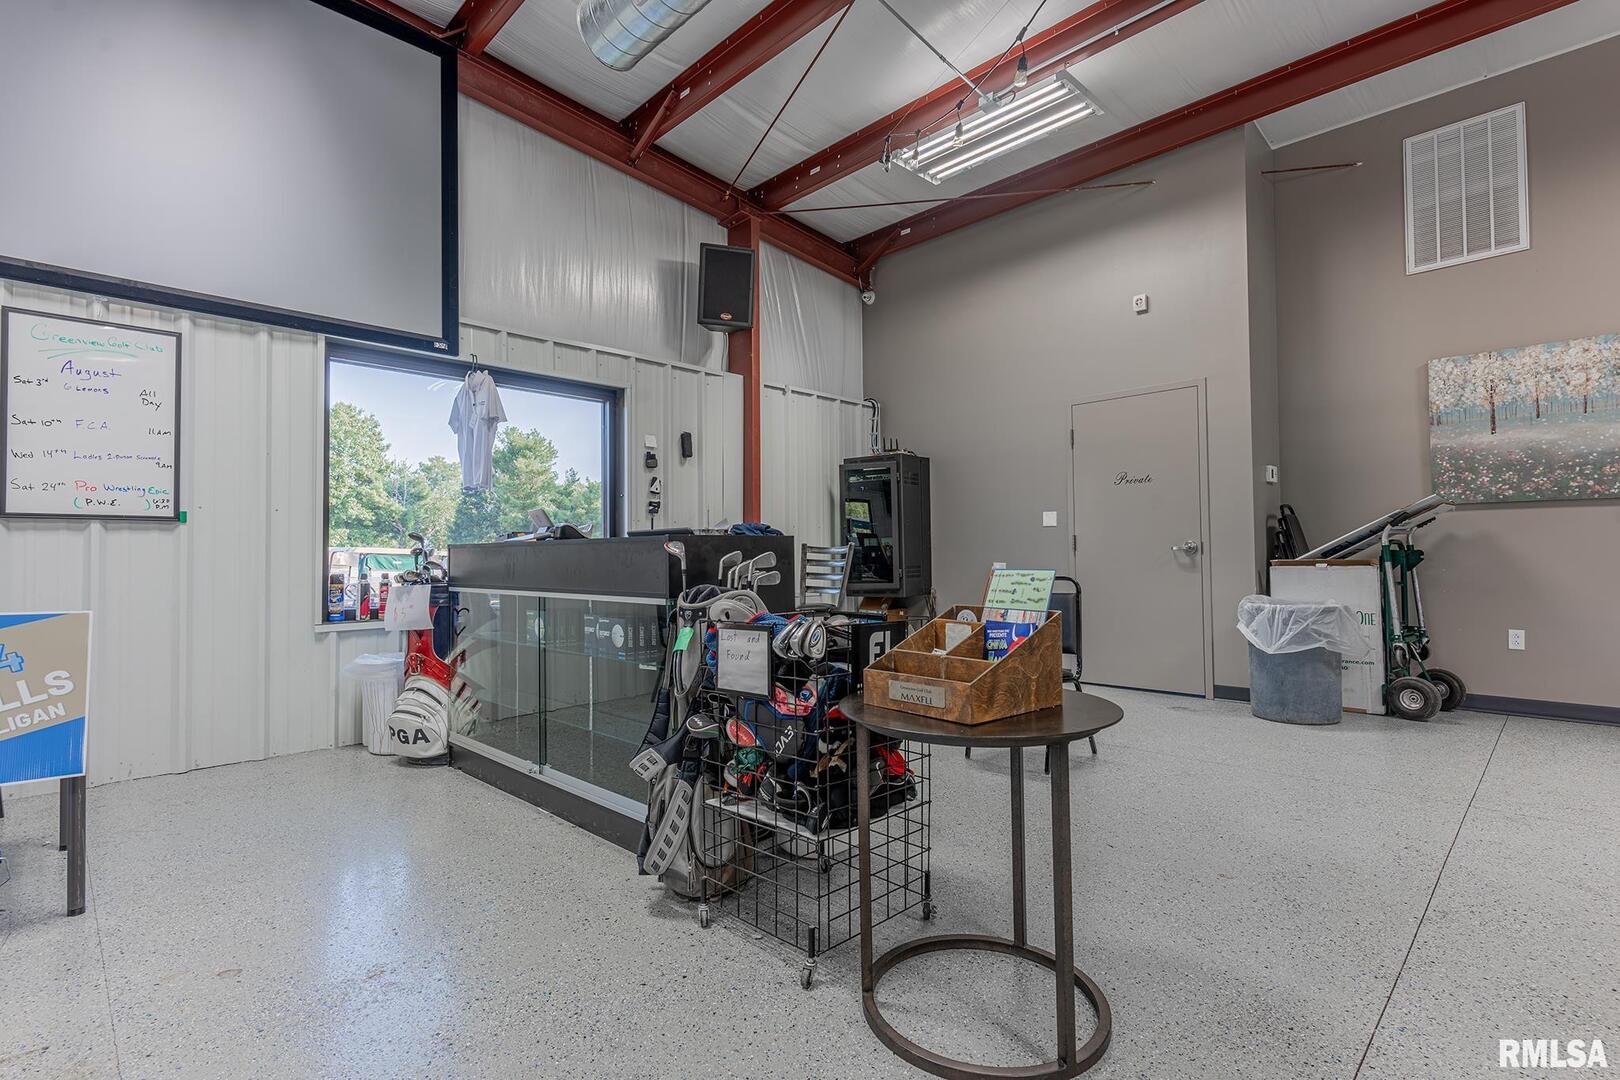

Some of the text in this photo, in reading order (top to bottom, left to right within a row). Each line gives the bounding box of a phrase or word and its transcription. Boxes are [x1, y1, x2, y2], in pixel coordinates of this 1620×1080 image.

[60, 360, 122, 381] August
[141, 397, 162, 411] Day
[11, 413, 37, 426] Sat
[11, 448, 34, 459] Wed
[10, 477, 35, 491] Sat
[1113, 471, 1153, 486] Private
[74, 480, 98, 493] Pro
[103, 483, 146, 498] Wrestling
[720, 631, 761, 644] Lost and
[726, 650, 751, 662] Found
[388, 725, 431, 745] PGA
